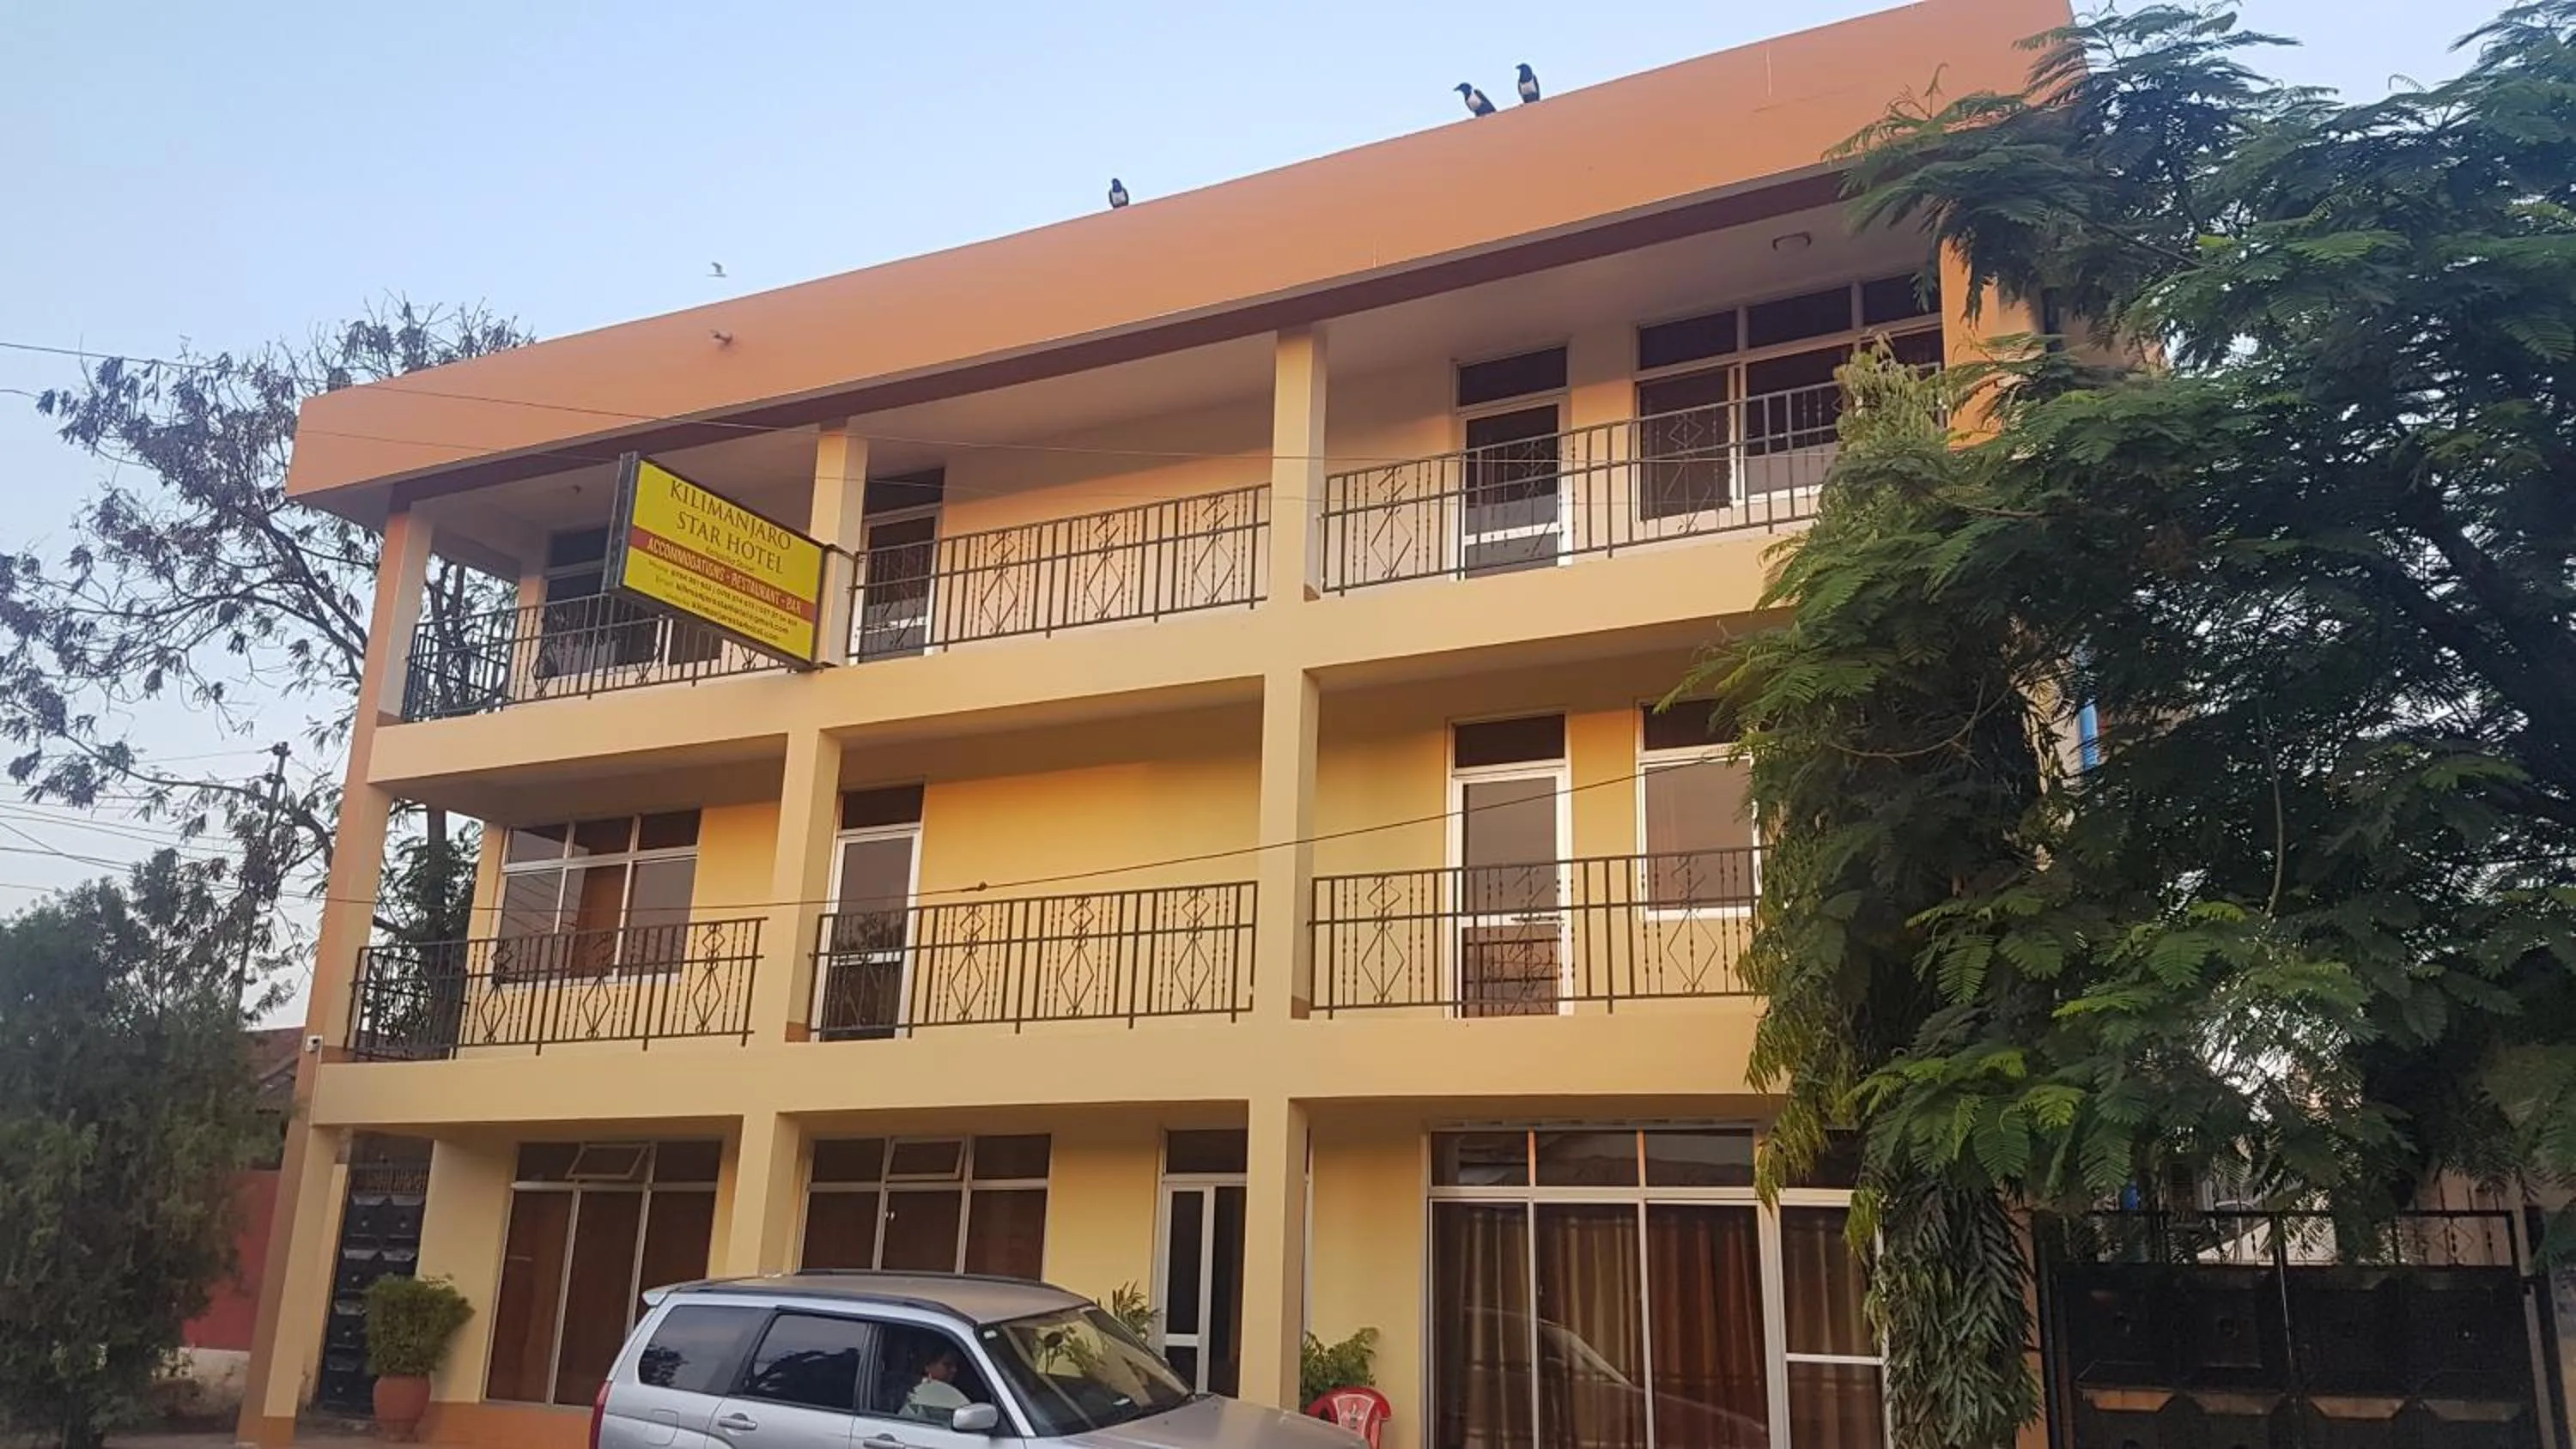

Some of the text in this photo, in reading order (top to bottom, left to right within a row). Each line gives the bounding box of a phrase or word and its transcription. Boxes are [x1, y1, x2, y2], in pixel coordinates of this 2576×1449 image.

[670, 480, 791, 550] KILIMANJARO
[677, 512, 720, 544] STAR
[727, 533, 783, 574] HOTEL
[732, 573, 779, 605] RESTAURANT
